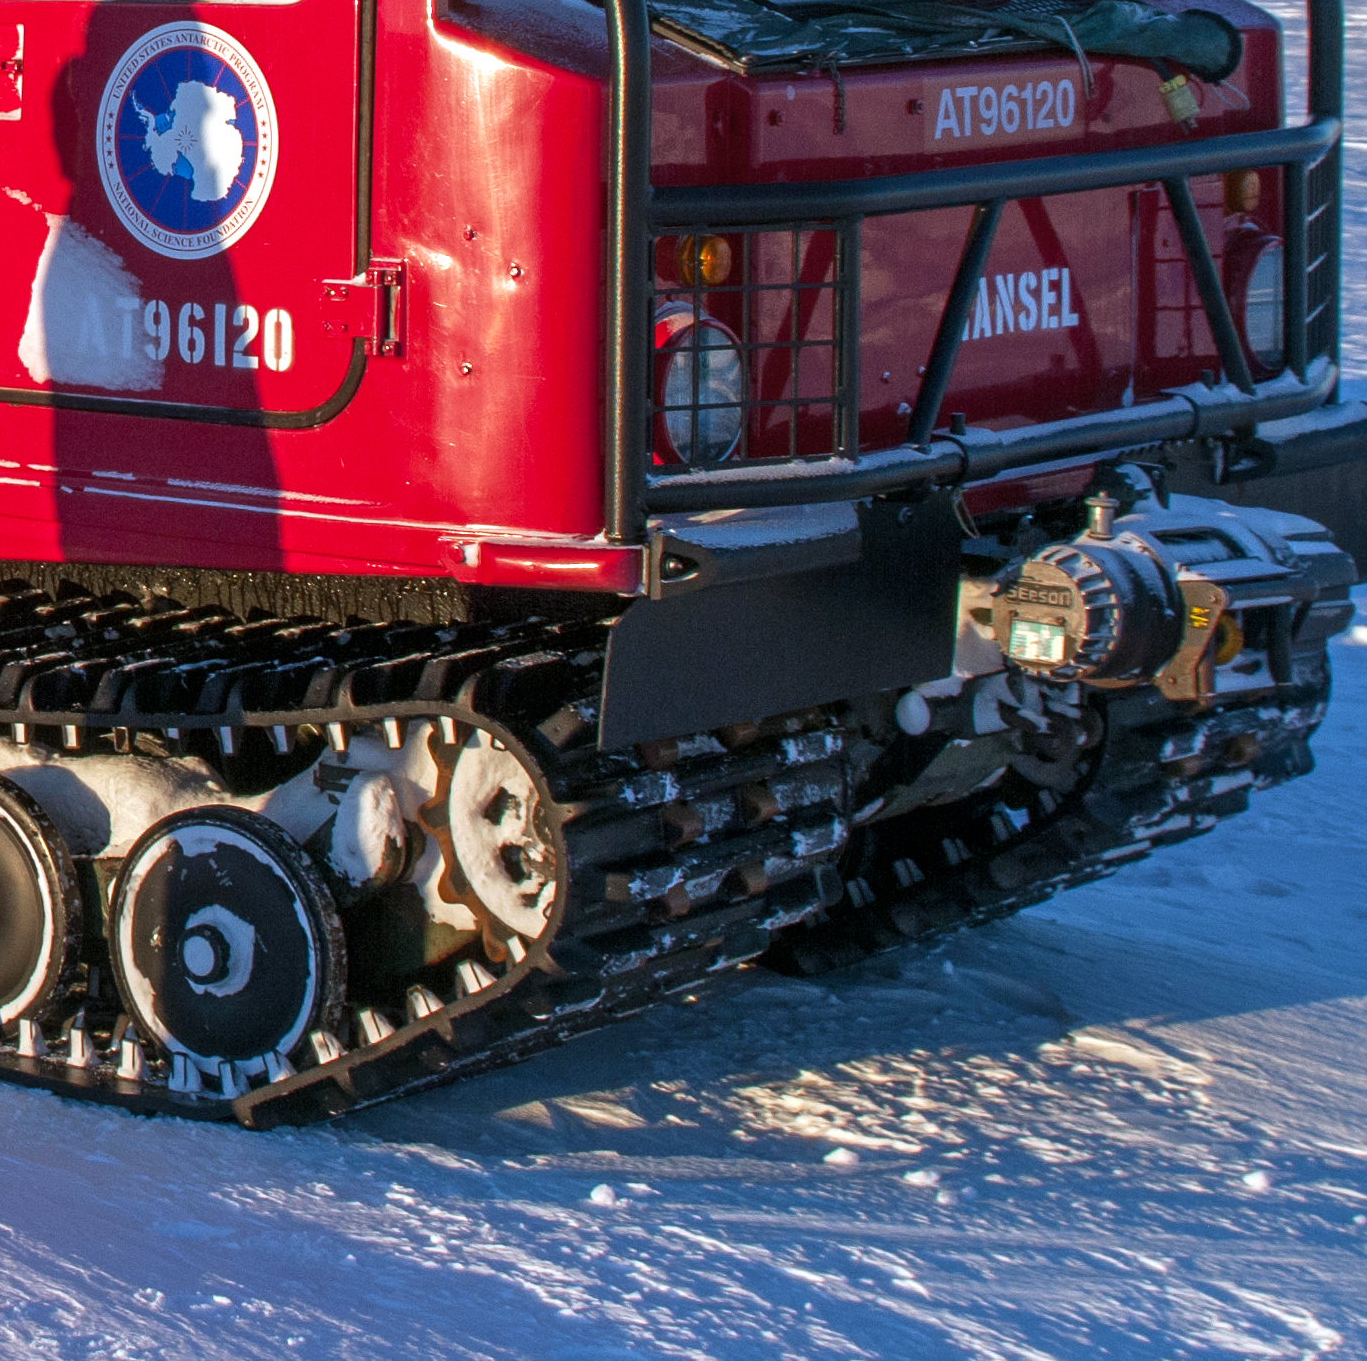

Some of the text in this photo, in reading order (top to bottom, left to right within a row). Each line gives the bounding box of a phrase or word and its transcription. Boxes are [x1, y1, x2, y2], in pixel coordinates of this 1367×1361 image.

[113, 33, 266, 111] UNITED STATES ANTARCTIC PROGRAM
[934, 79, 1075, 139] AT96120
[113, 181, 255, 248] NATIONAL SCIENCE FOUNDATION
[962, 267, 1079, 341] ANSEL
